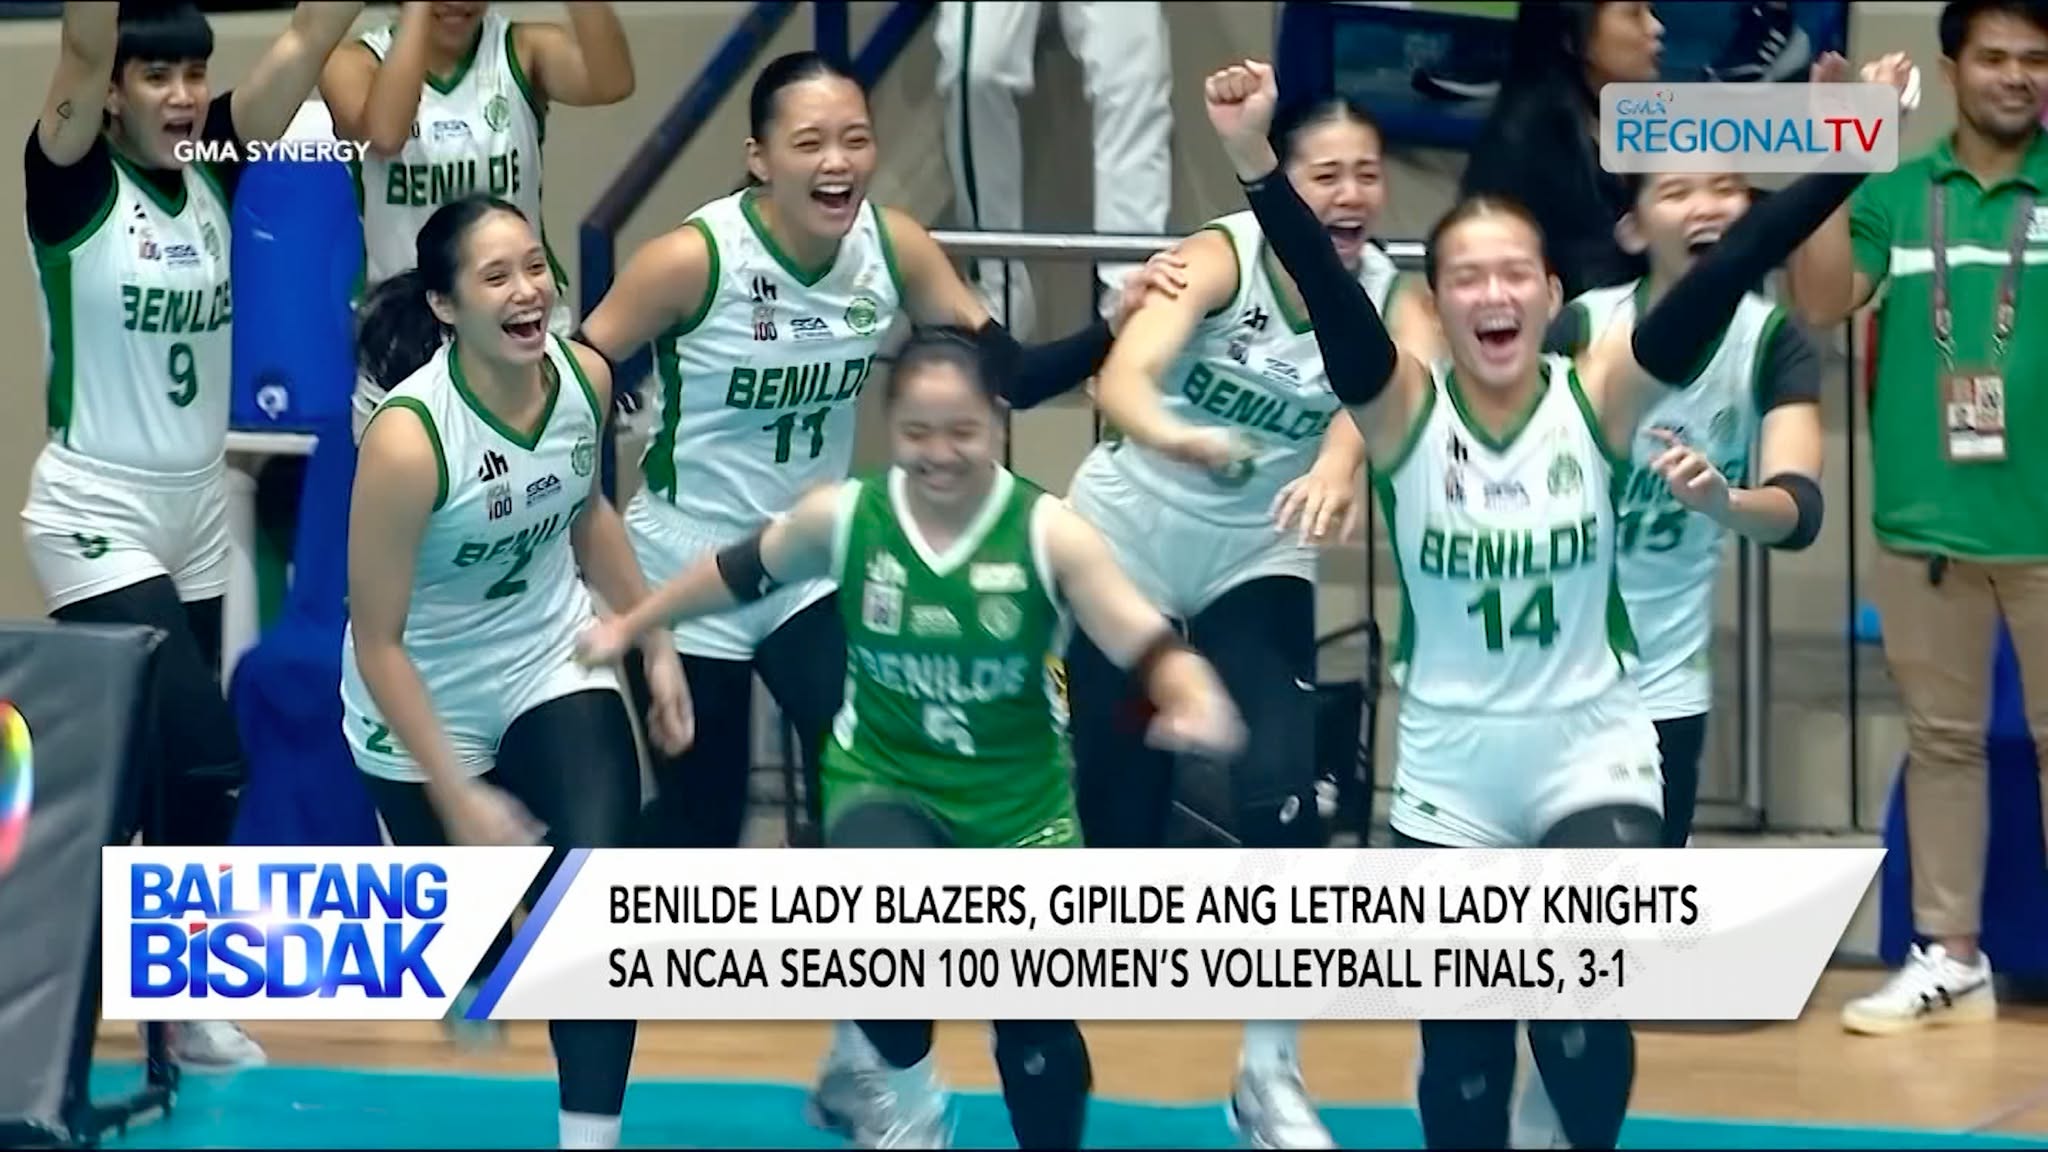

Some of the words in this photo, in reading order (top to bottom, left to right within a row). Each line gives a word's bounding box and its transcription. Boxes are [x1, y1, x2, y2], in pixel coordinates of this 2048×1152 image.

[167, 342, 198, 408] 9
[762, 406, 832, 464] 11
[488, 497, 513, 521] 100
[1420, 515, 1598, 580] BENILDE
[1467, 584, 1561, 653] 14
[362, 715, 393, 755] 2
